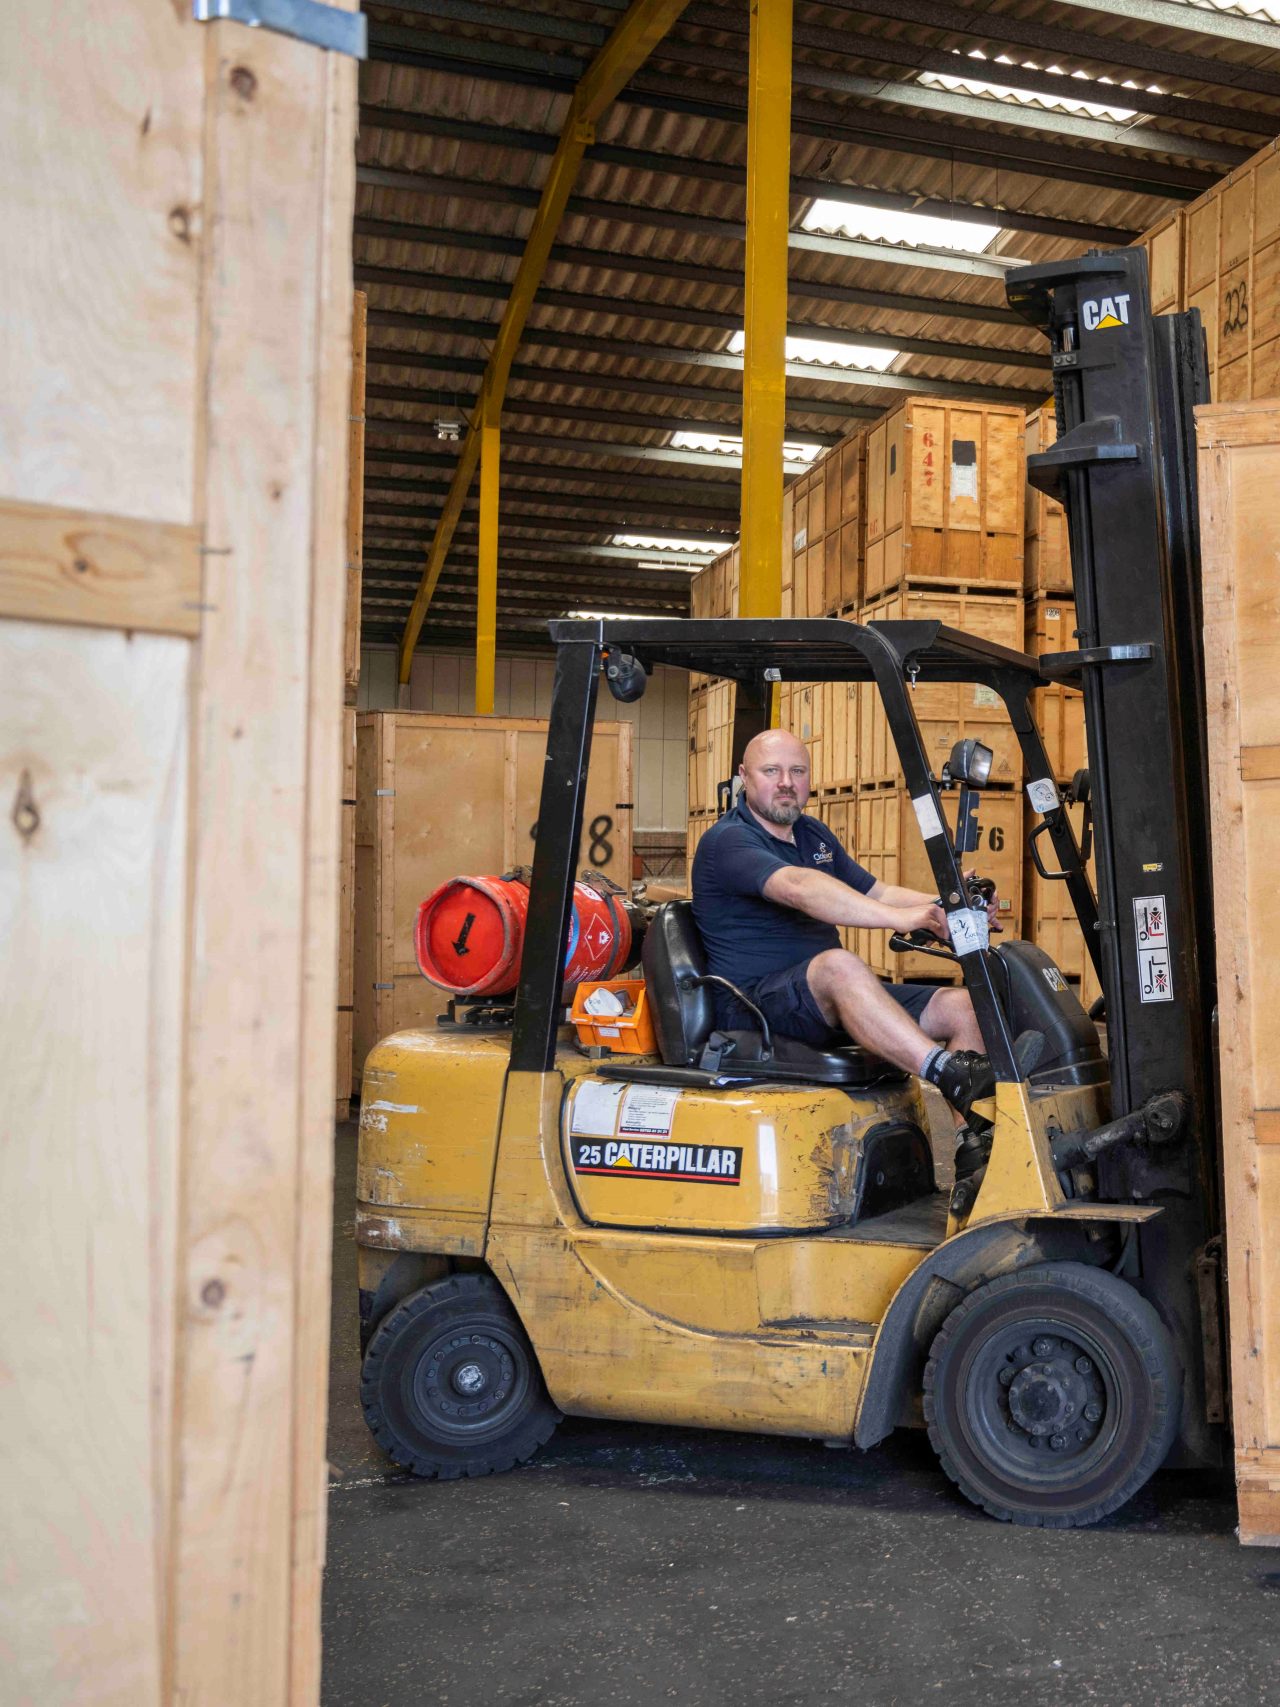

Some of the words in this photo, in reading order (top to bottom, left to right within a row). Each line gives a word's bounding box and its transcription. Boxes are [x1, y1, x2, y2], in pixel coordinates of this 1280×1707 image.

[1082, 294, 1131, 331] CAT
[1042, 967, 1069, 992] CAT
[579, 1145, 601, 1165] 25
[604, 1141, 737, 1175] CATERPILLAR
